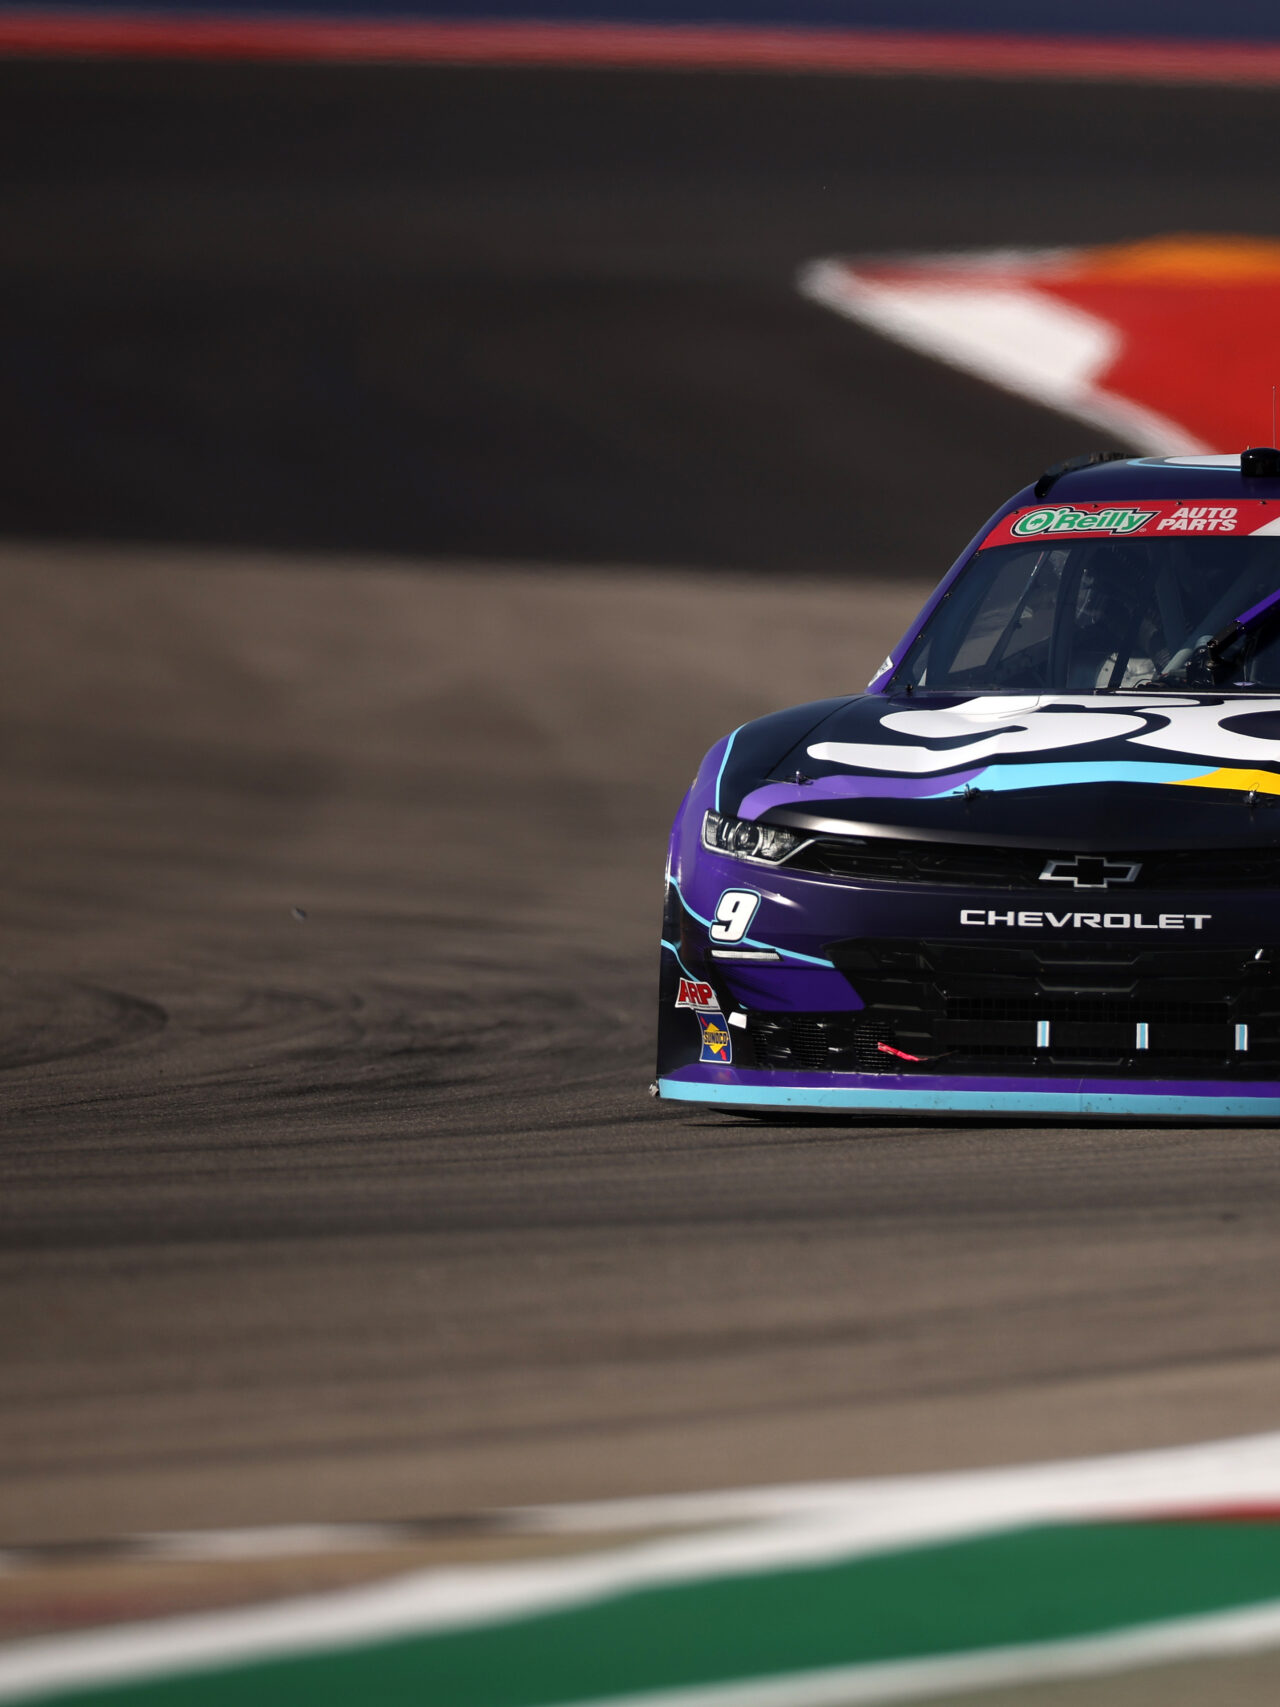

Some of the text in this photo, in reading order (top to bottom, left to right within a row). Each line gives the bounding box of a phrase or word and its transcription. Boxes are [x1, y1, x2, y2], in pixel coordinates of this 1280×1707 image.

[1018, 508, 1148, 533] O'Reilly
[1172, 507, 1237, 519] AUTO
[1156, 518, 1237, 531] PARTS
[710, 891, 759, 941] 9
[960, 909, 1212, 930] CHEVROLET
[679, 980, 712, 1005] ARP
[704, 1032, 728, 1045] SUNOCO
